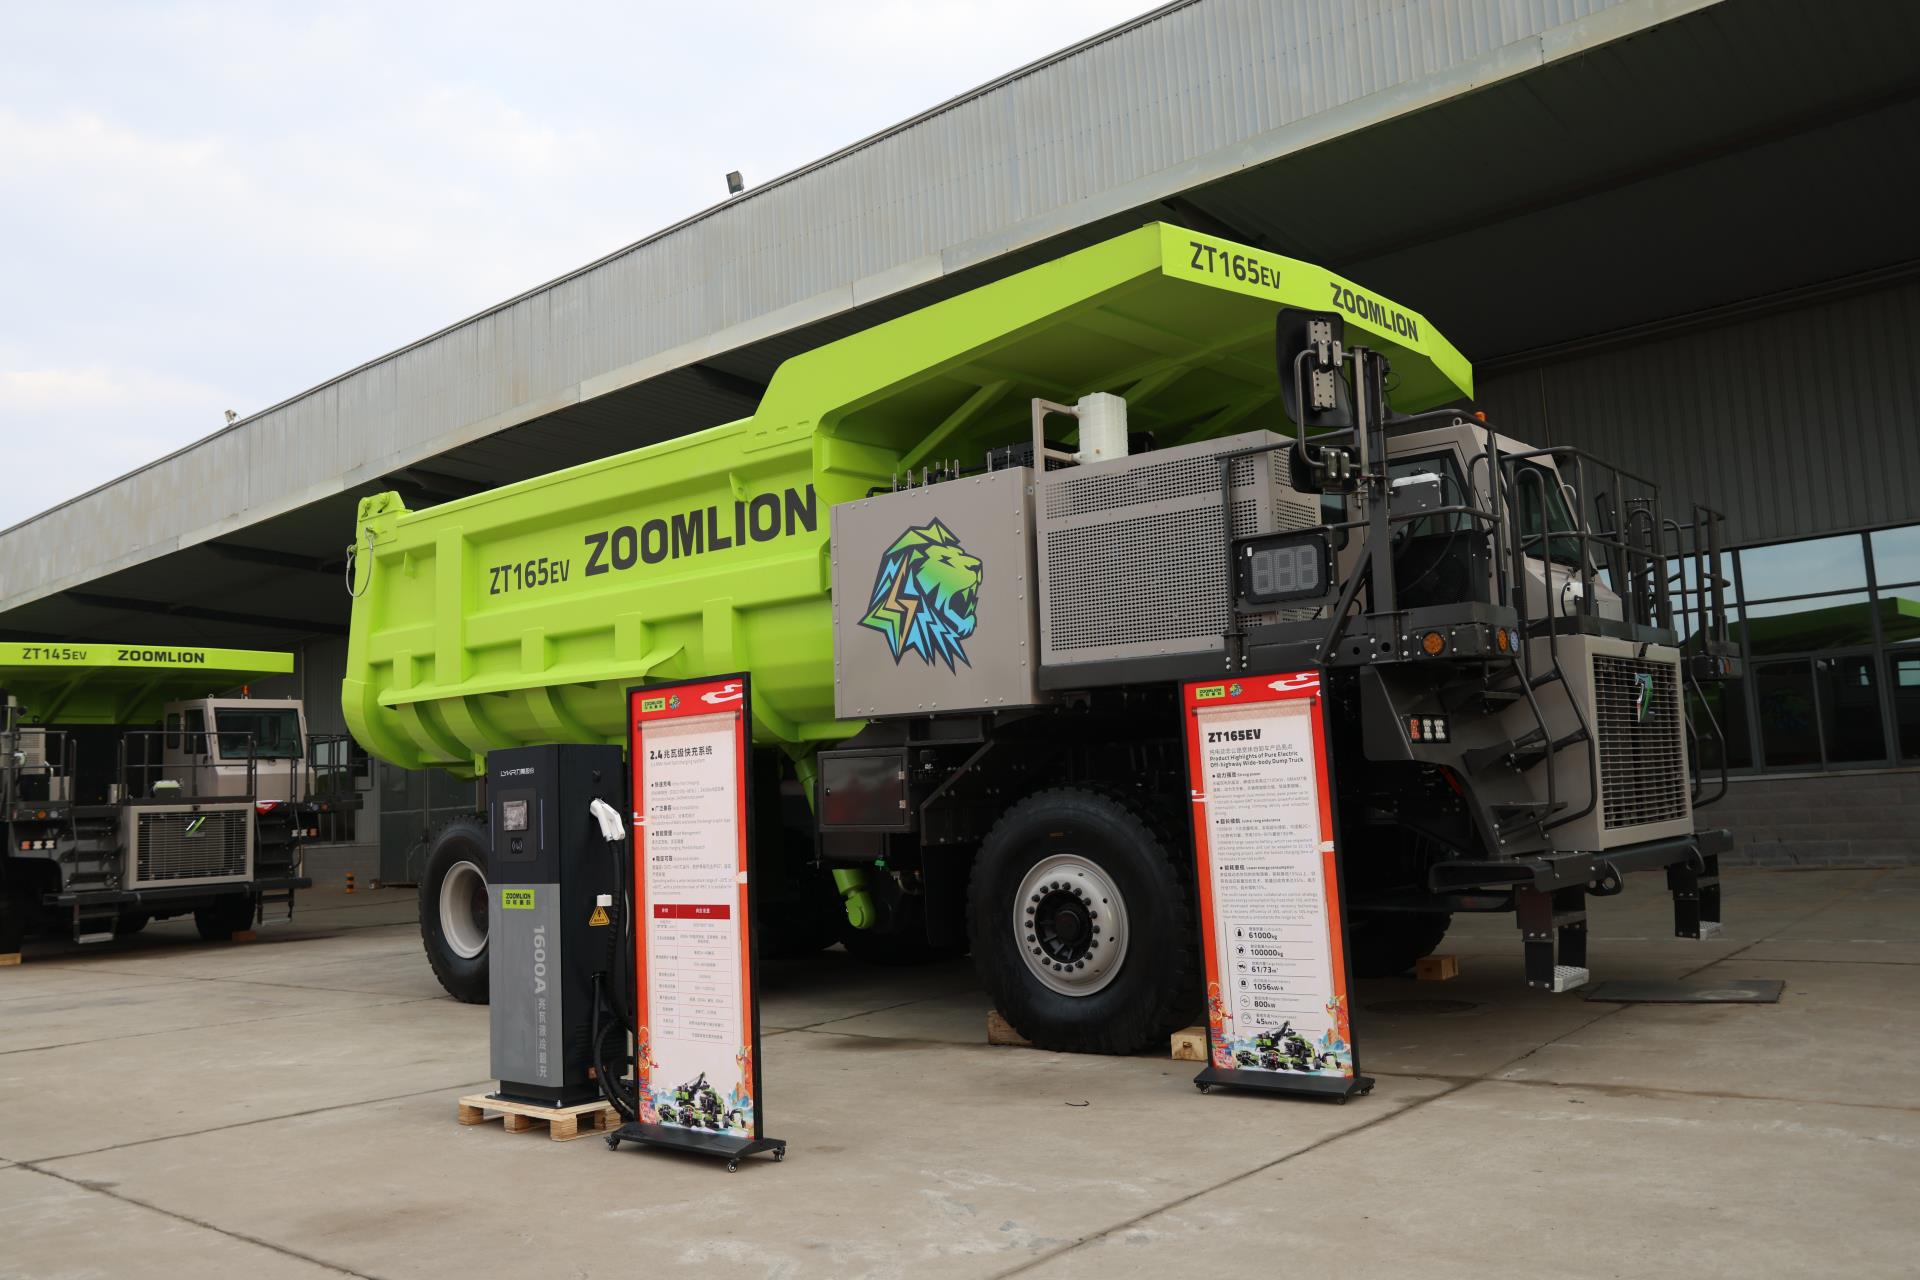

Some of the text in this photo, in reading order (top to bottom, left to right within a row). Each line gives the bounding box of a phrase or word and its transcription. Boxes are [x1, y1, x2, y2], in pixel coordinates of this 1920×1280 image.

[1190, 241, 1419, 342] ZT165EV ZOOMLION
[490, 484, 817, 595] ZT165EV ZOOMLION
[22, 648, 205, 663] ZT145EV ZOOMLION
[1208, 729, 1261, 743] ZT165EV
[1248, 932, 1277, 940] 61000kg
[533, 925, 546, 994] 1600A
[1250, 949, 1284, 957] 100000kg
